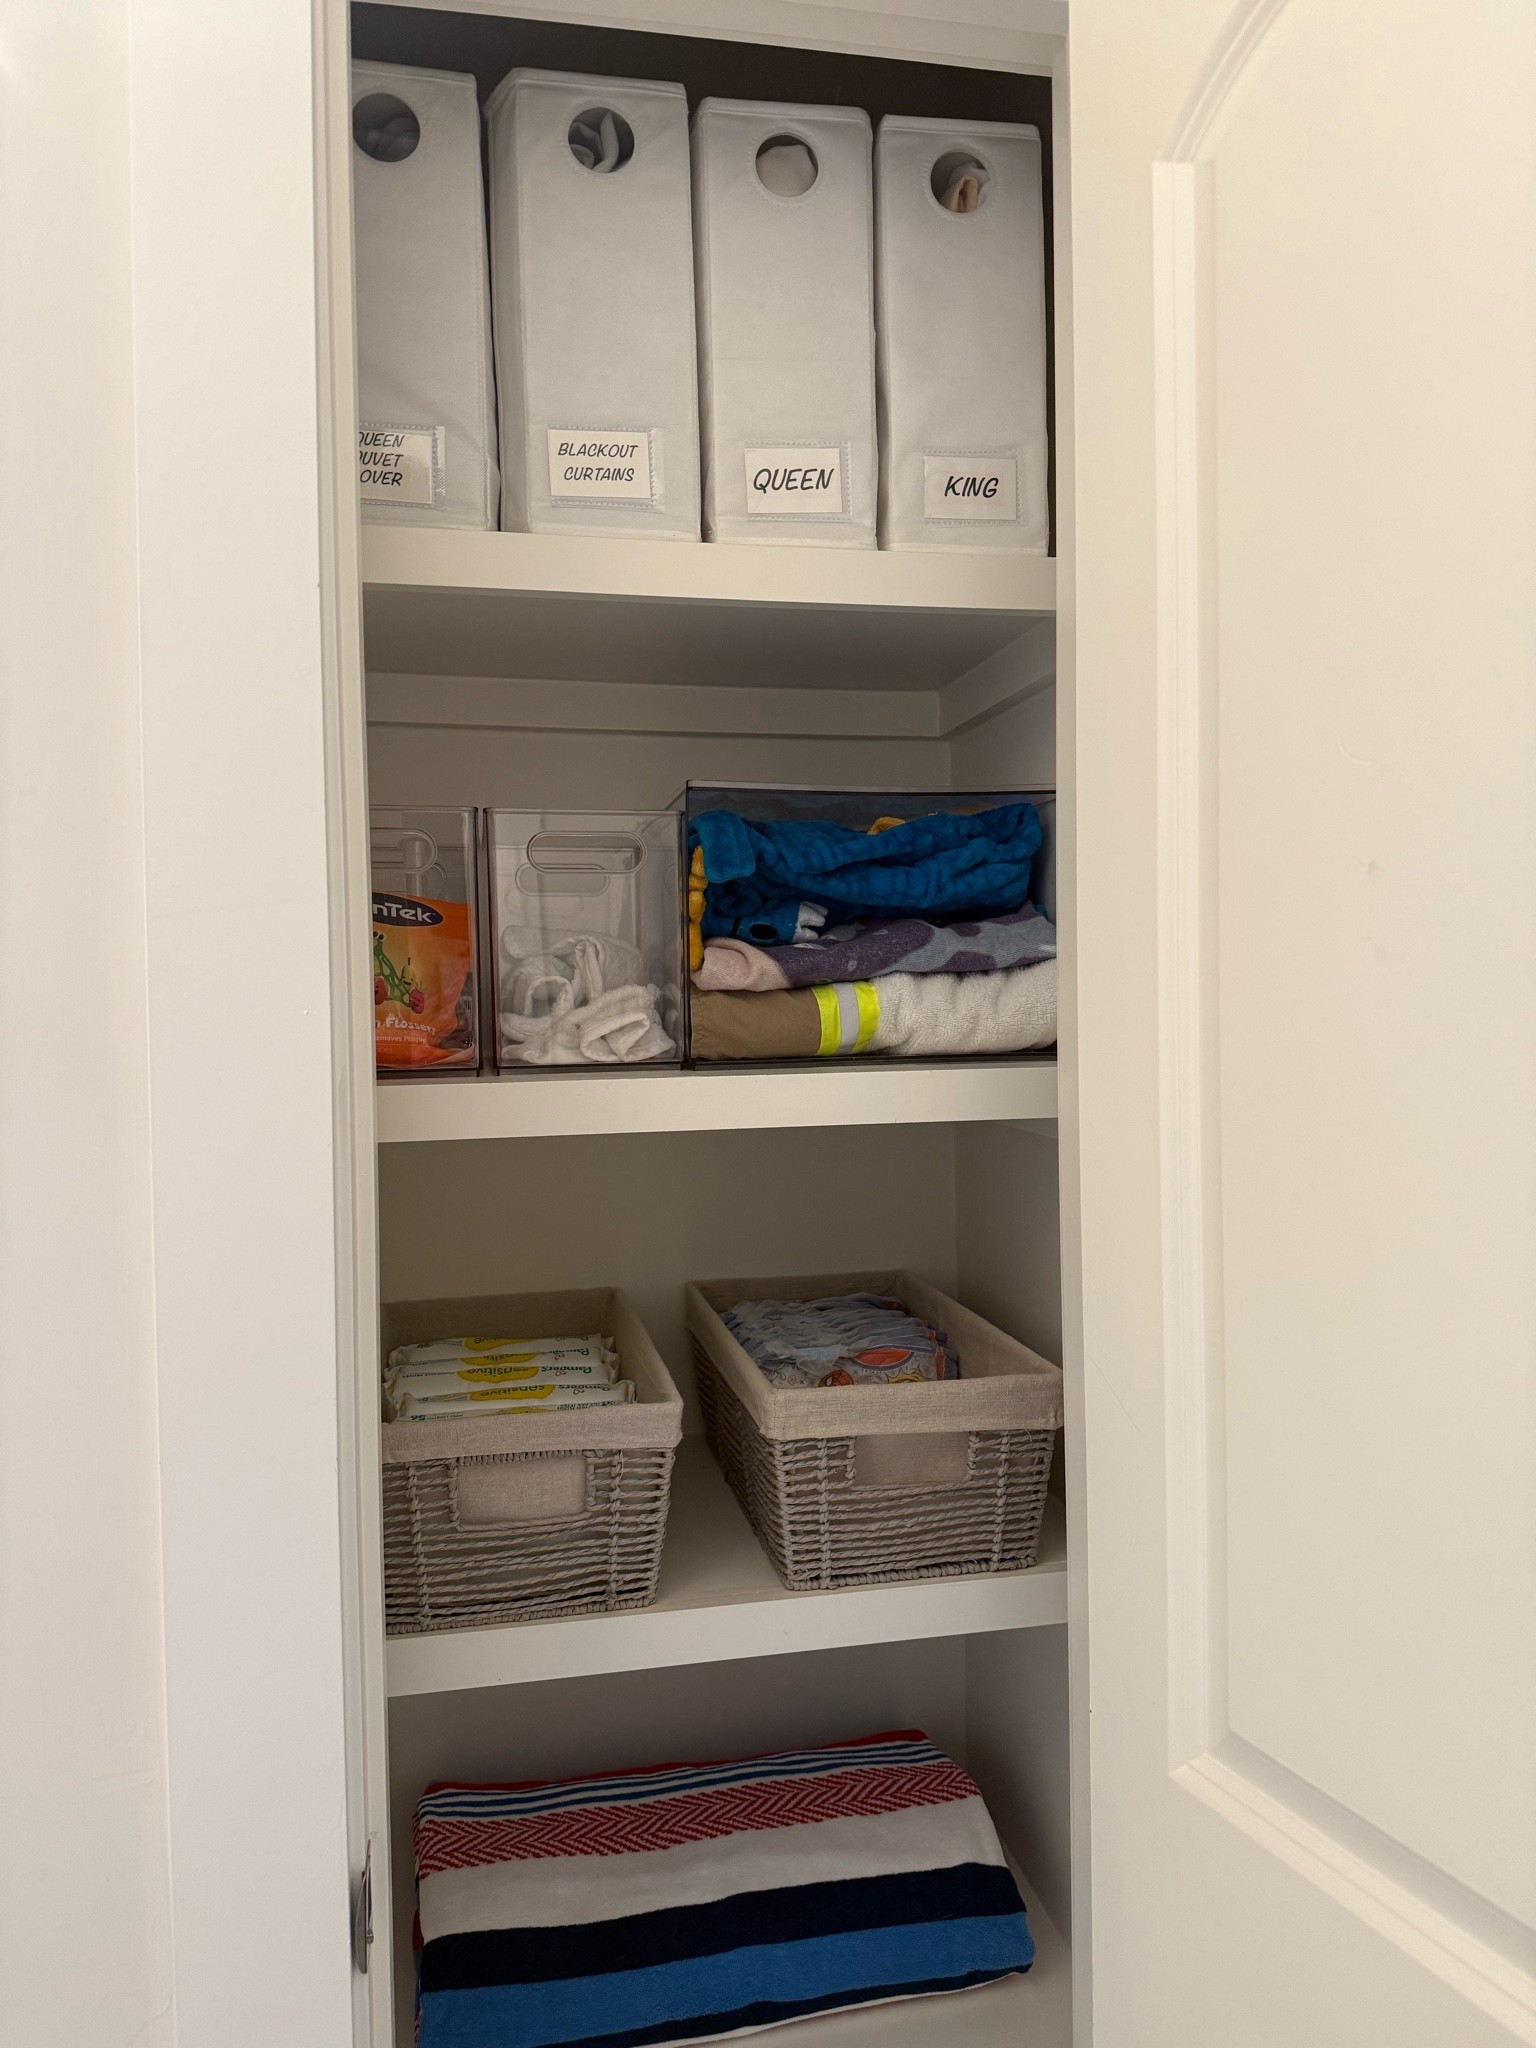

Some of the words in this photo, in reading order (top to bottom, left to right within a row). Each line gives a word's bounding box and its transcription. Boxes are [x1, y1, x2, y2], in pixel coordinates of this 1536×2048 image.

[558, 442, 638, 458] BLACKOUT
[360, 469, 403, 486] OVER
[564, 466, 635, 482] CURTAINS
[753, 468, 834, 494] QUEEN
[944, 475, 999, 498] KING
[372, 902, 433, 924] nTek
